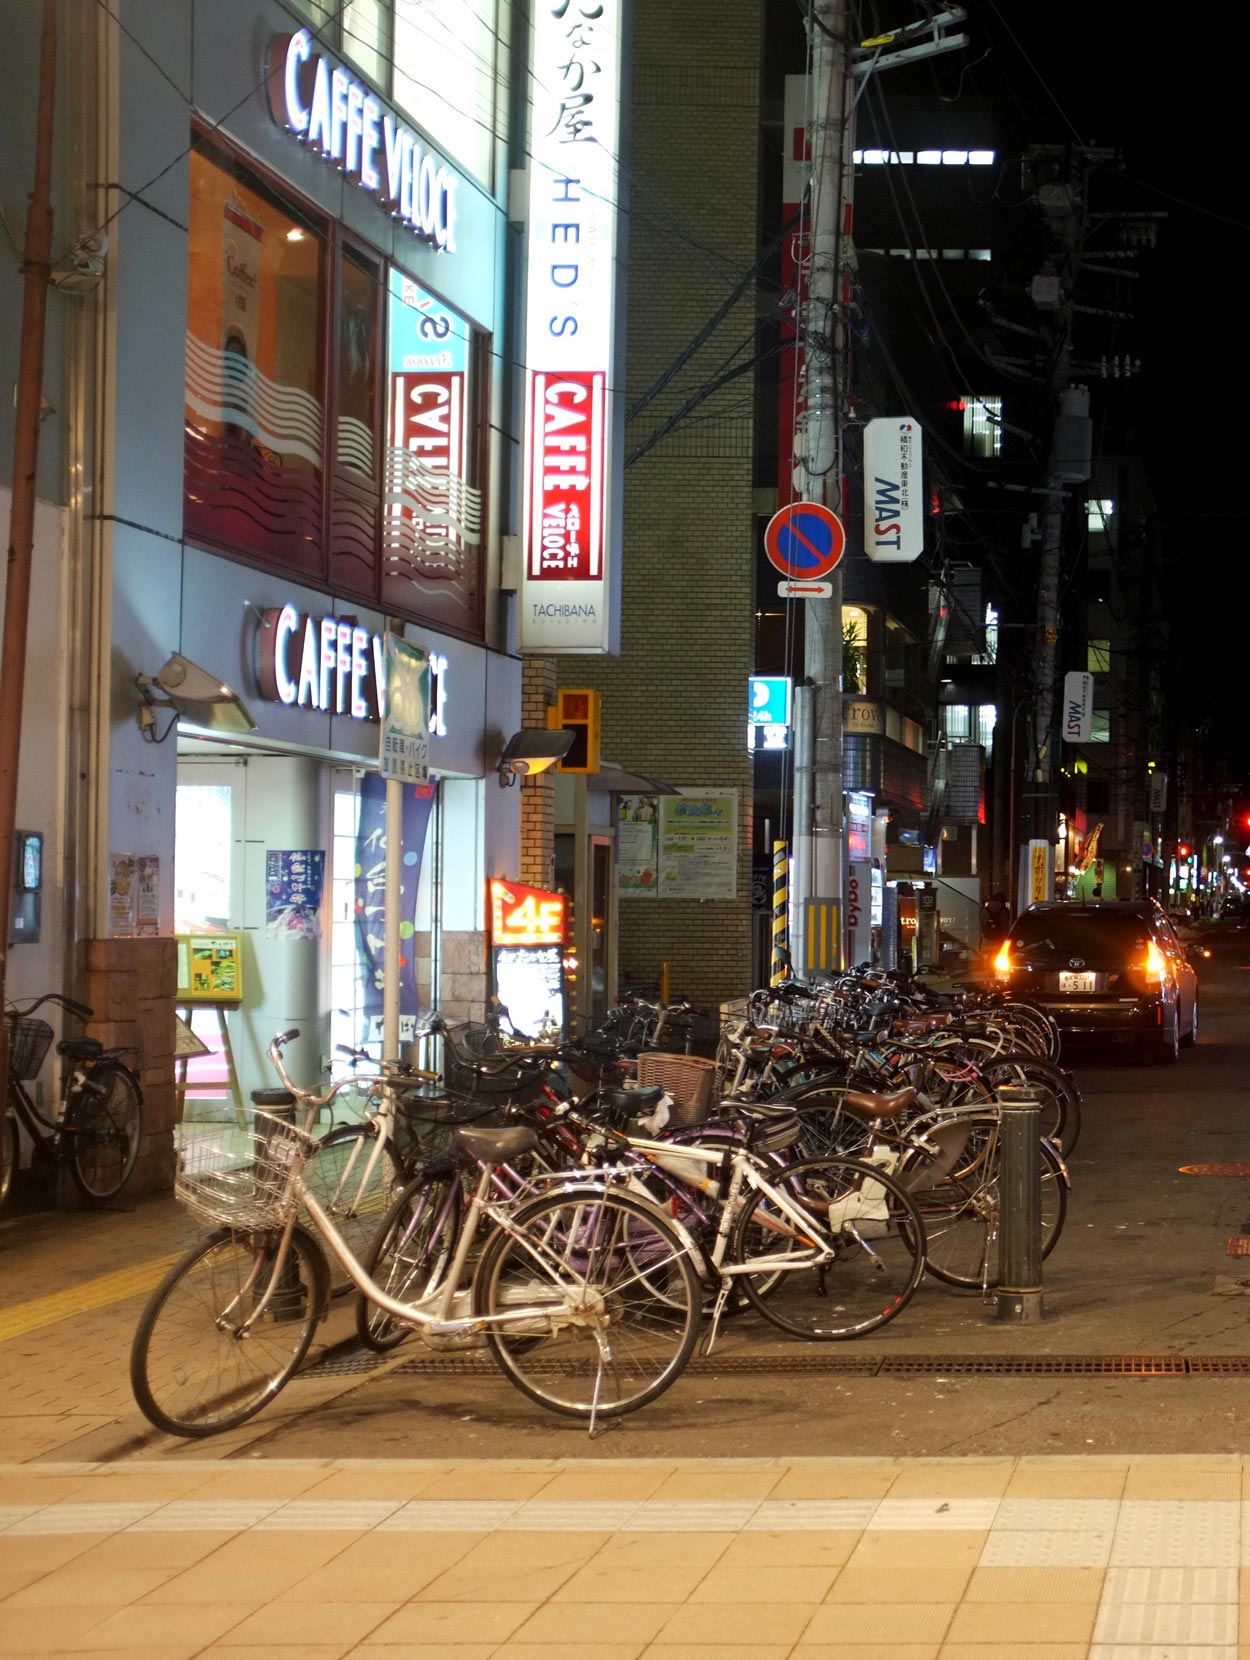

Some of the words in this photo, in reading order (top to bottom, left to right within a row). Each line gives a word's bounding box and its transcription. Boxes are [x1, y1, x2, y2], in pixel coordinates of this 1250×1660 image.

[543, 503, 566, 568] VELOCE
[874, 476, 901, 551] MAST
[533, 603, 596, 617] TACHIBANA
[275, 603, 368, 720] CAFFE
[1067, 700, 1082, 738] MAST
[505, 895, 562, 933] 4F
